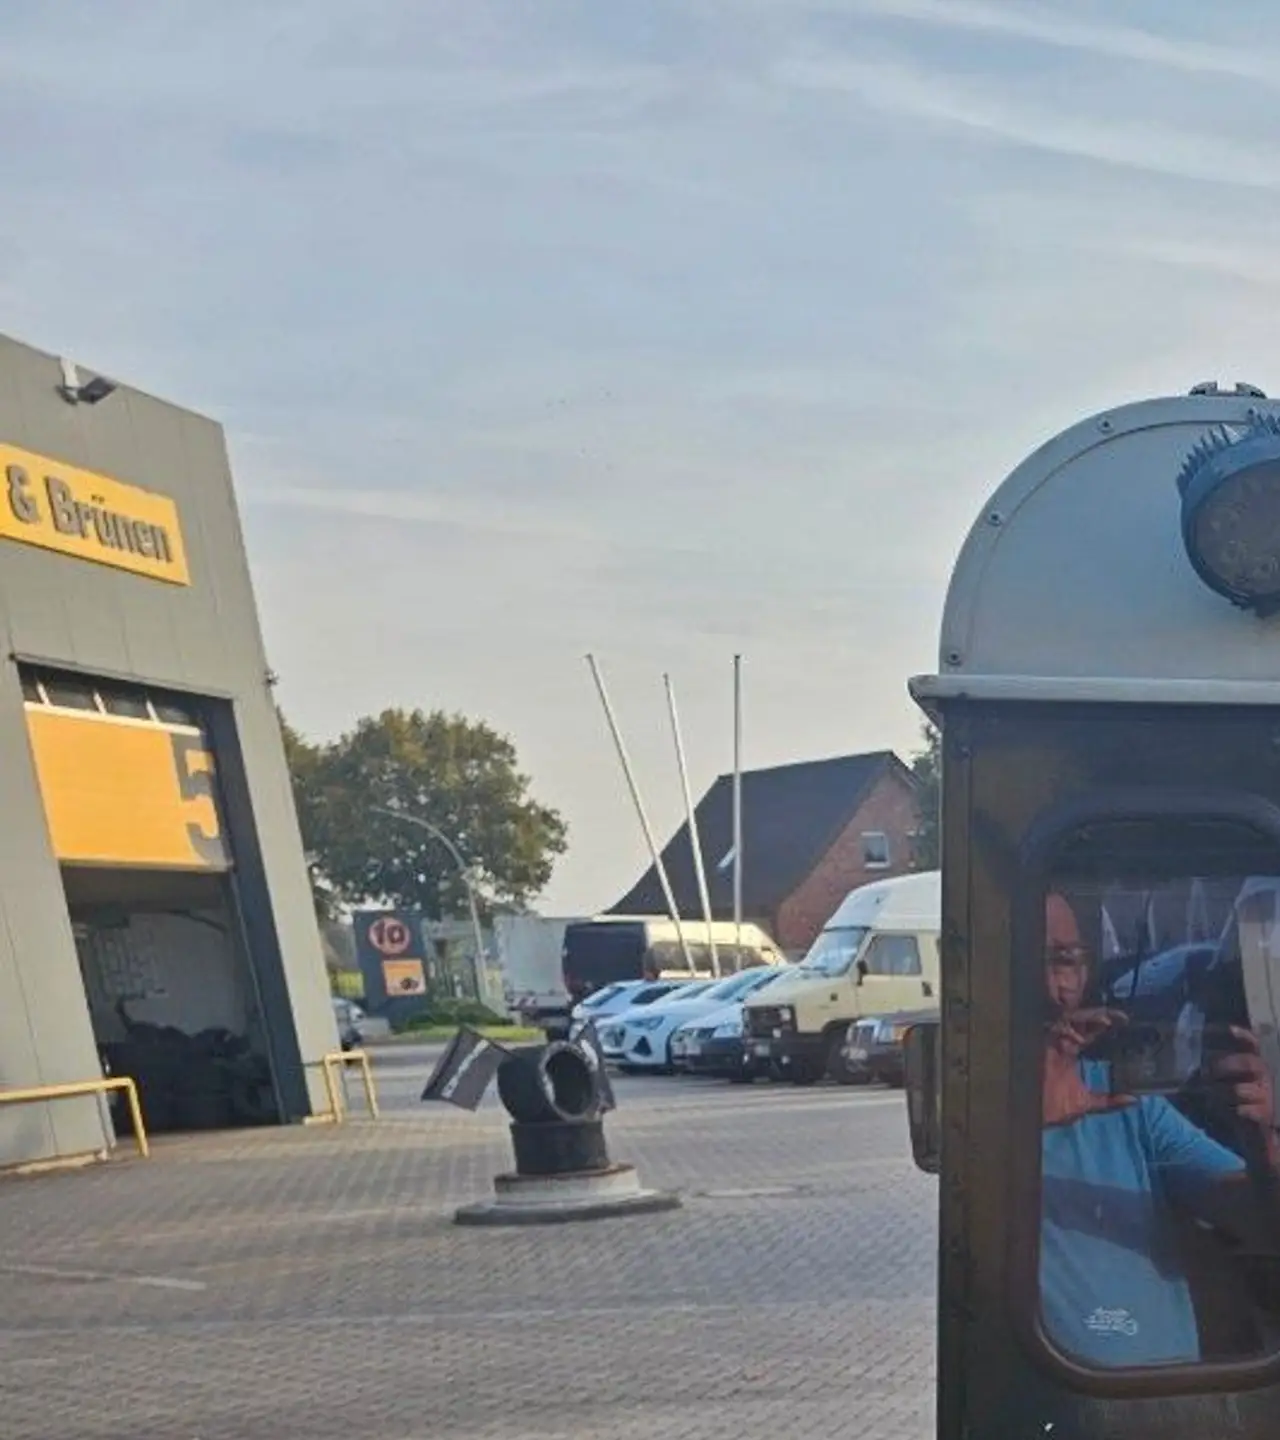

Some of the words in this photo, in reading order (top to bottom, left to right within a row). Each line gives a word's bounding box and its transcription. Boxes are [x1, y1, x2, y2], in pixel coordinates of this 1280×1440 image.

[6, 464, 41, 524] &
[44, 475, 172, 562] Brünen
[168, 733, 234, 868] 5
[374, 919, 408, 945] 10
